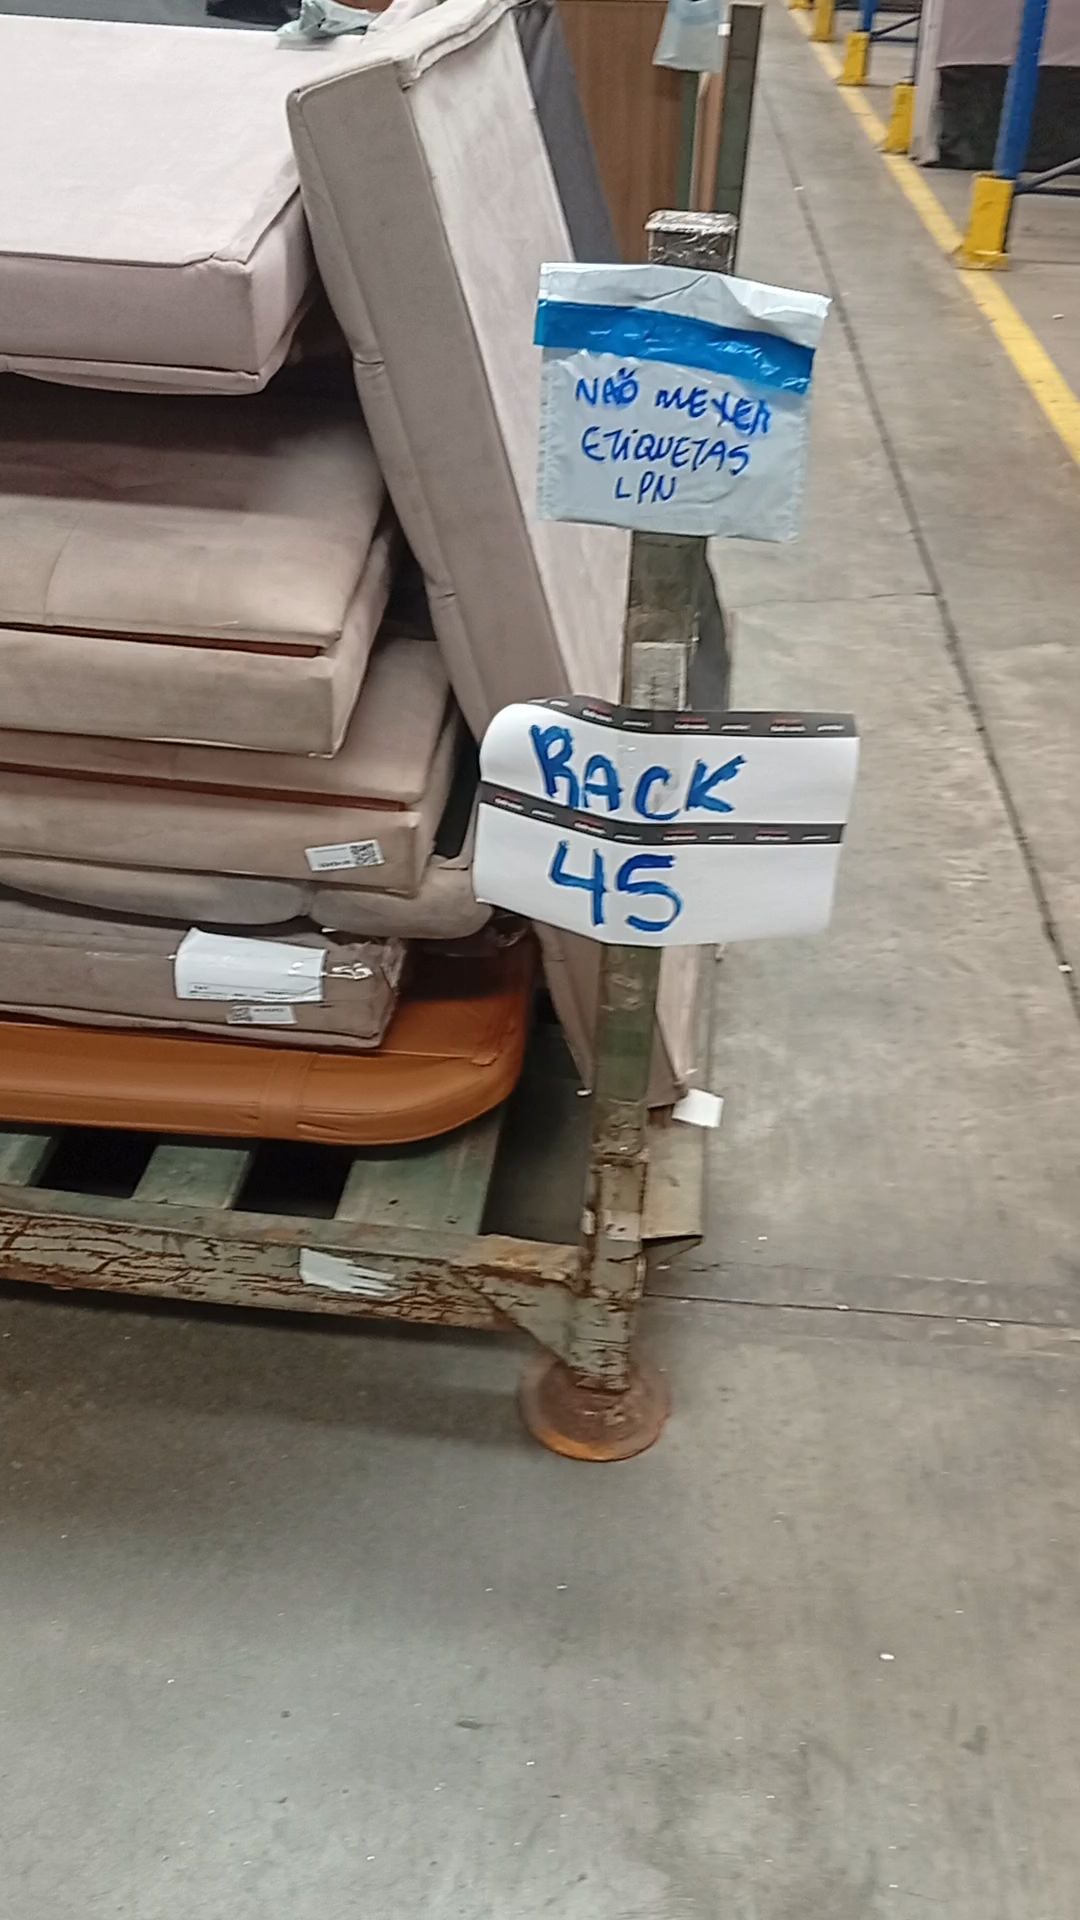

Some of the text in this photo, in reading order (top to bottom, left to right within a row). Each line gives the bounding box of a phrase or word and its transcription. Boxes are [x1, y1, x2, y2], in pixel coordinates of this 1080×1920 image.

[615, 471, 676, 504] LPN
[530, 725, 745, 820] RACK
[548, 840, 683, 932] 45
